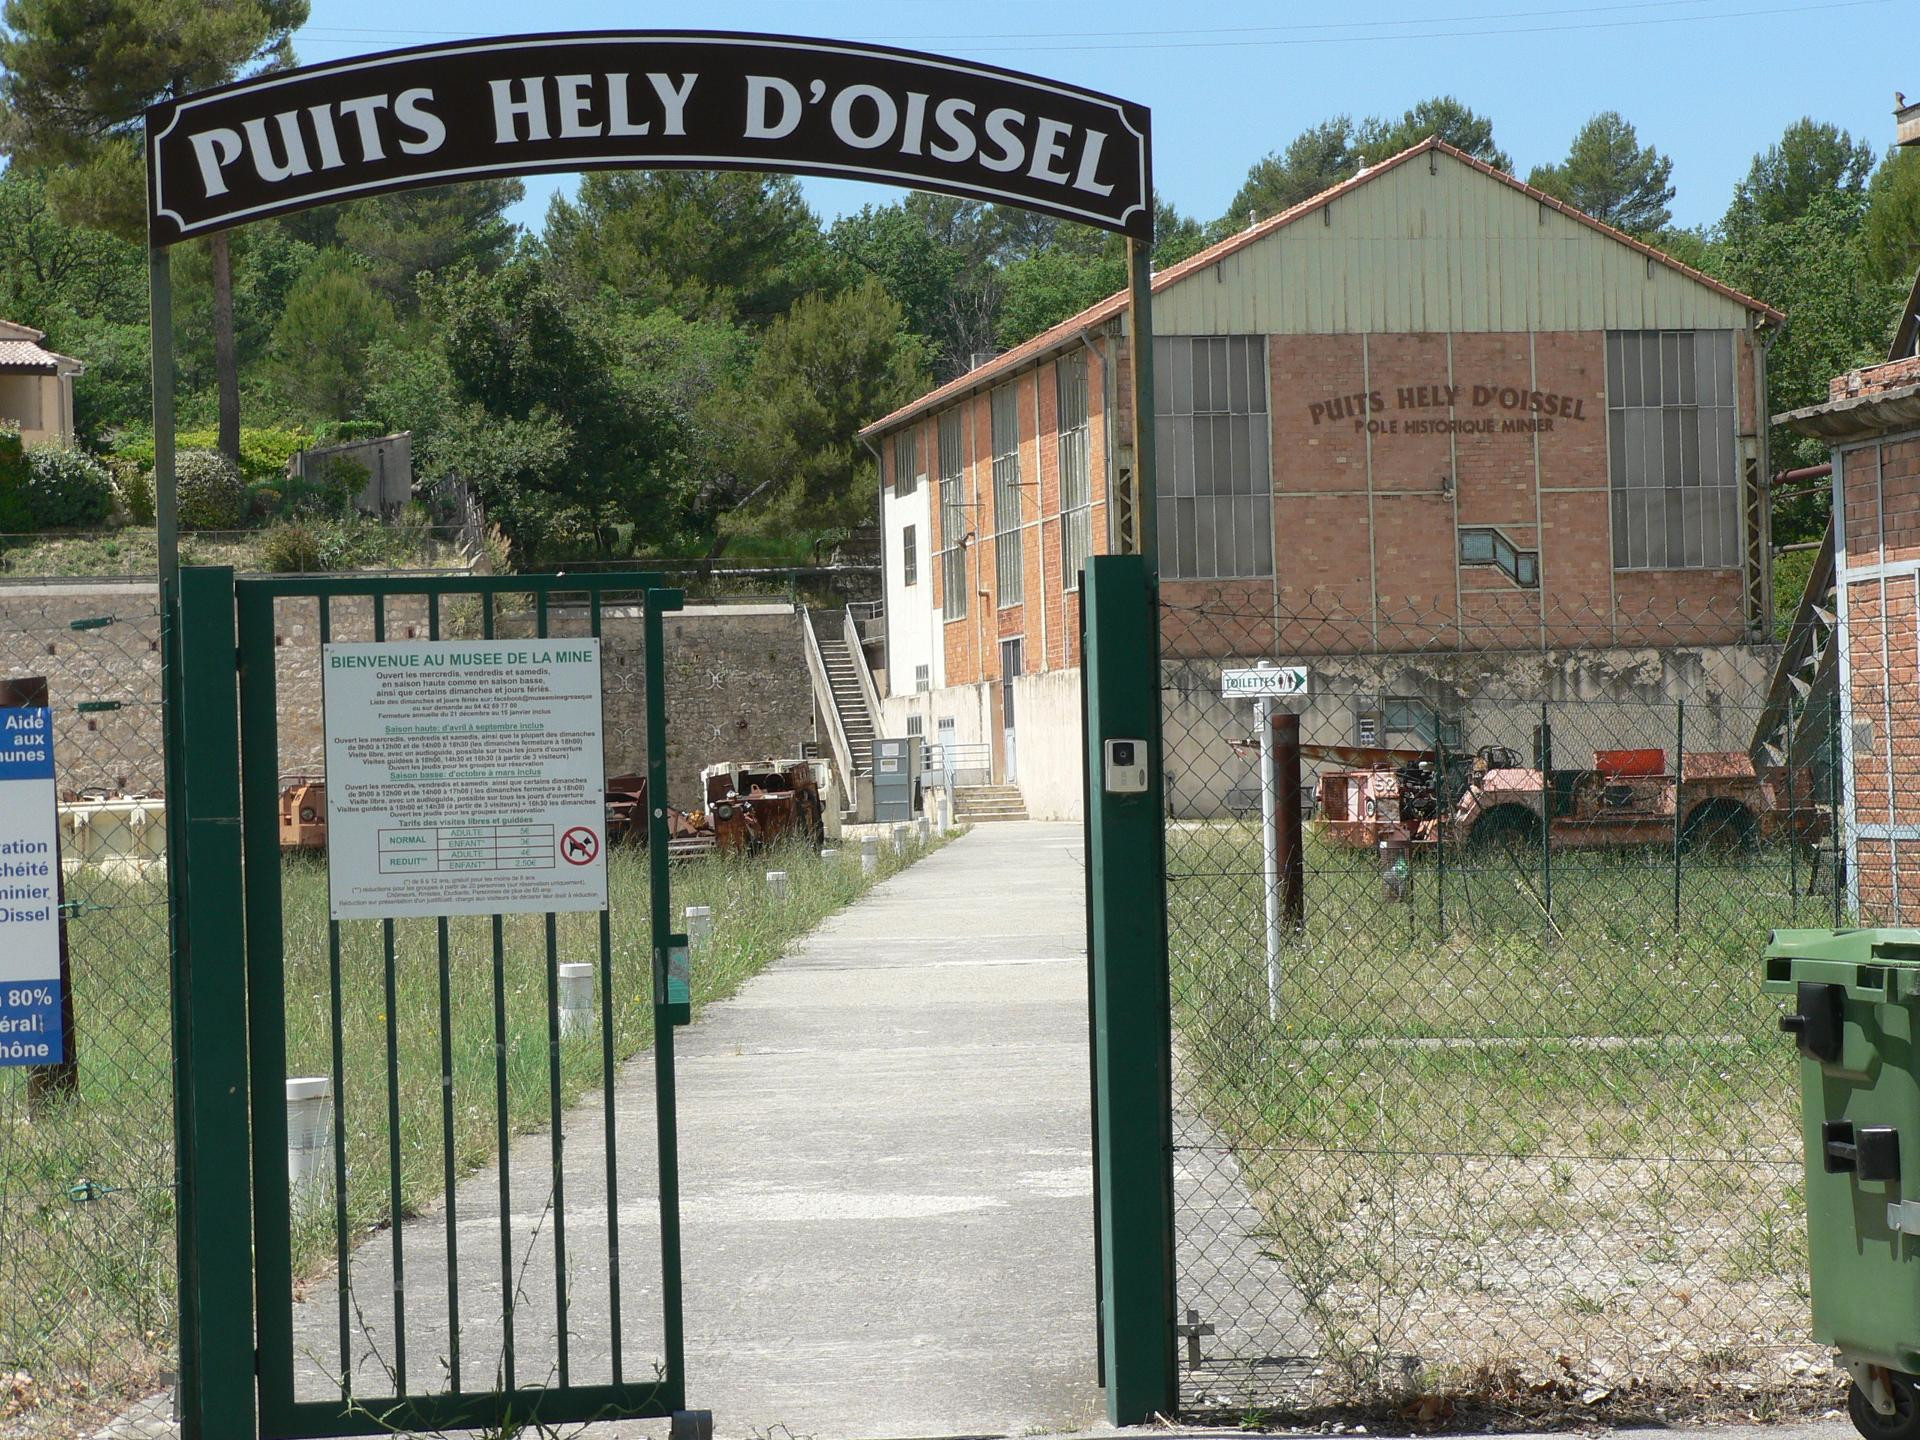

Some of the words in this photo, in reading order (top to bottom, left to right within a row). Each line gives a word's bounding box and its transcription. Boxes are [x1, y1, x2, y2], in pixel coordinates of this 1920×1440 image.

[188, 87, 447, 198] PUITS
[488, 72, 699, 144] HELY
[743, 75, 1115, 197] D'OISSEL
[1308, 391, 1385, 425] PUITS
[1397, 385, 1460, 409] HELY
[1404, 418, 1495, 434] HISTORIQUE
[1501, 417, 1554, 433] MINIER
[331, 654, 418, 668] BIENVENUE
[423, 654, 444, 666] AU
[449, 652, 502, 665] MUSEE
[507, 652, 527, 664] DE
[532, 652, 551, 663] LA
[555, 650, 591, 662] MINE
[1225, 677, 1276, 689] TOILETTES
[5, 715, 44, 730] Aide
[14, 734, 45, 746] aux
[0, 750, 46, 762] unes
[501, 817, 533, 825] guidées
[0, 839, 48, 855] ation
[389, 836, 427, 844] NORMAL
[451, 850, 483, 858] ADULTE
[0, 861, 49, 877] héité
[8, 986, 53, 1007] 80%
[0, 1014, 37, 1033] éral
